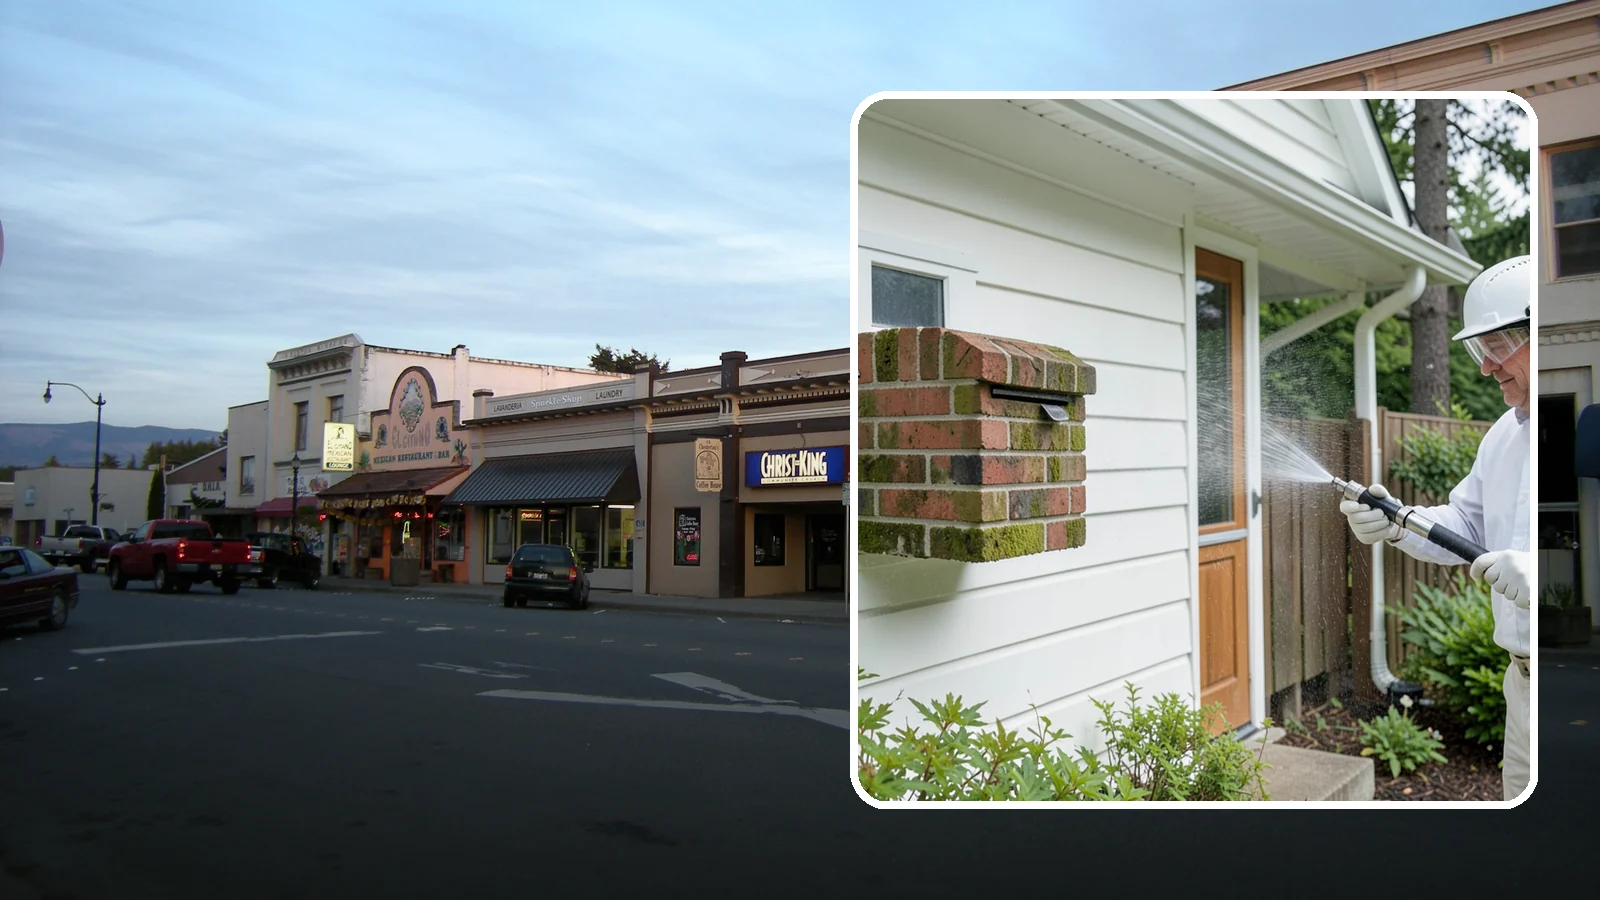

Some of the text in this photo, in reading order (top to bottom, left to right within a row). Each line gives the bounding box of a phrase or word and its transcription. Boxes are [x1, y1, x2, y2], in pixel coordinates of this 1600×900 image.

[530, 394, 582, 409] Sparkle Shop
[595, 389, 623, 400] LAUNDRY
[493, 402, 522, 412] LAVANDERIA
[392, 425, 402, 449] EL
[373, 455, 396, 464] MEXICAN
[397, 451, 433, 462] RESTAURANT
[438, 450, 450, 459] BAR
[761, 452, 797, 478] CHRIST
[799, 450, 827, 476] KING
